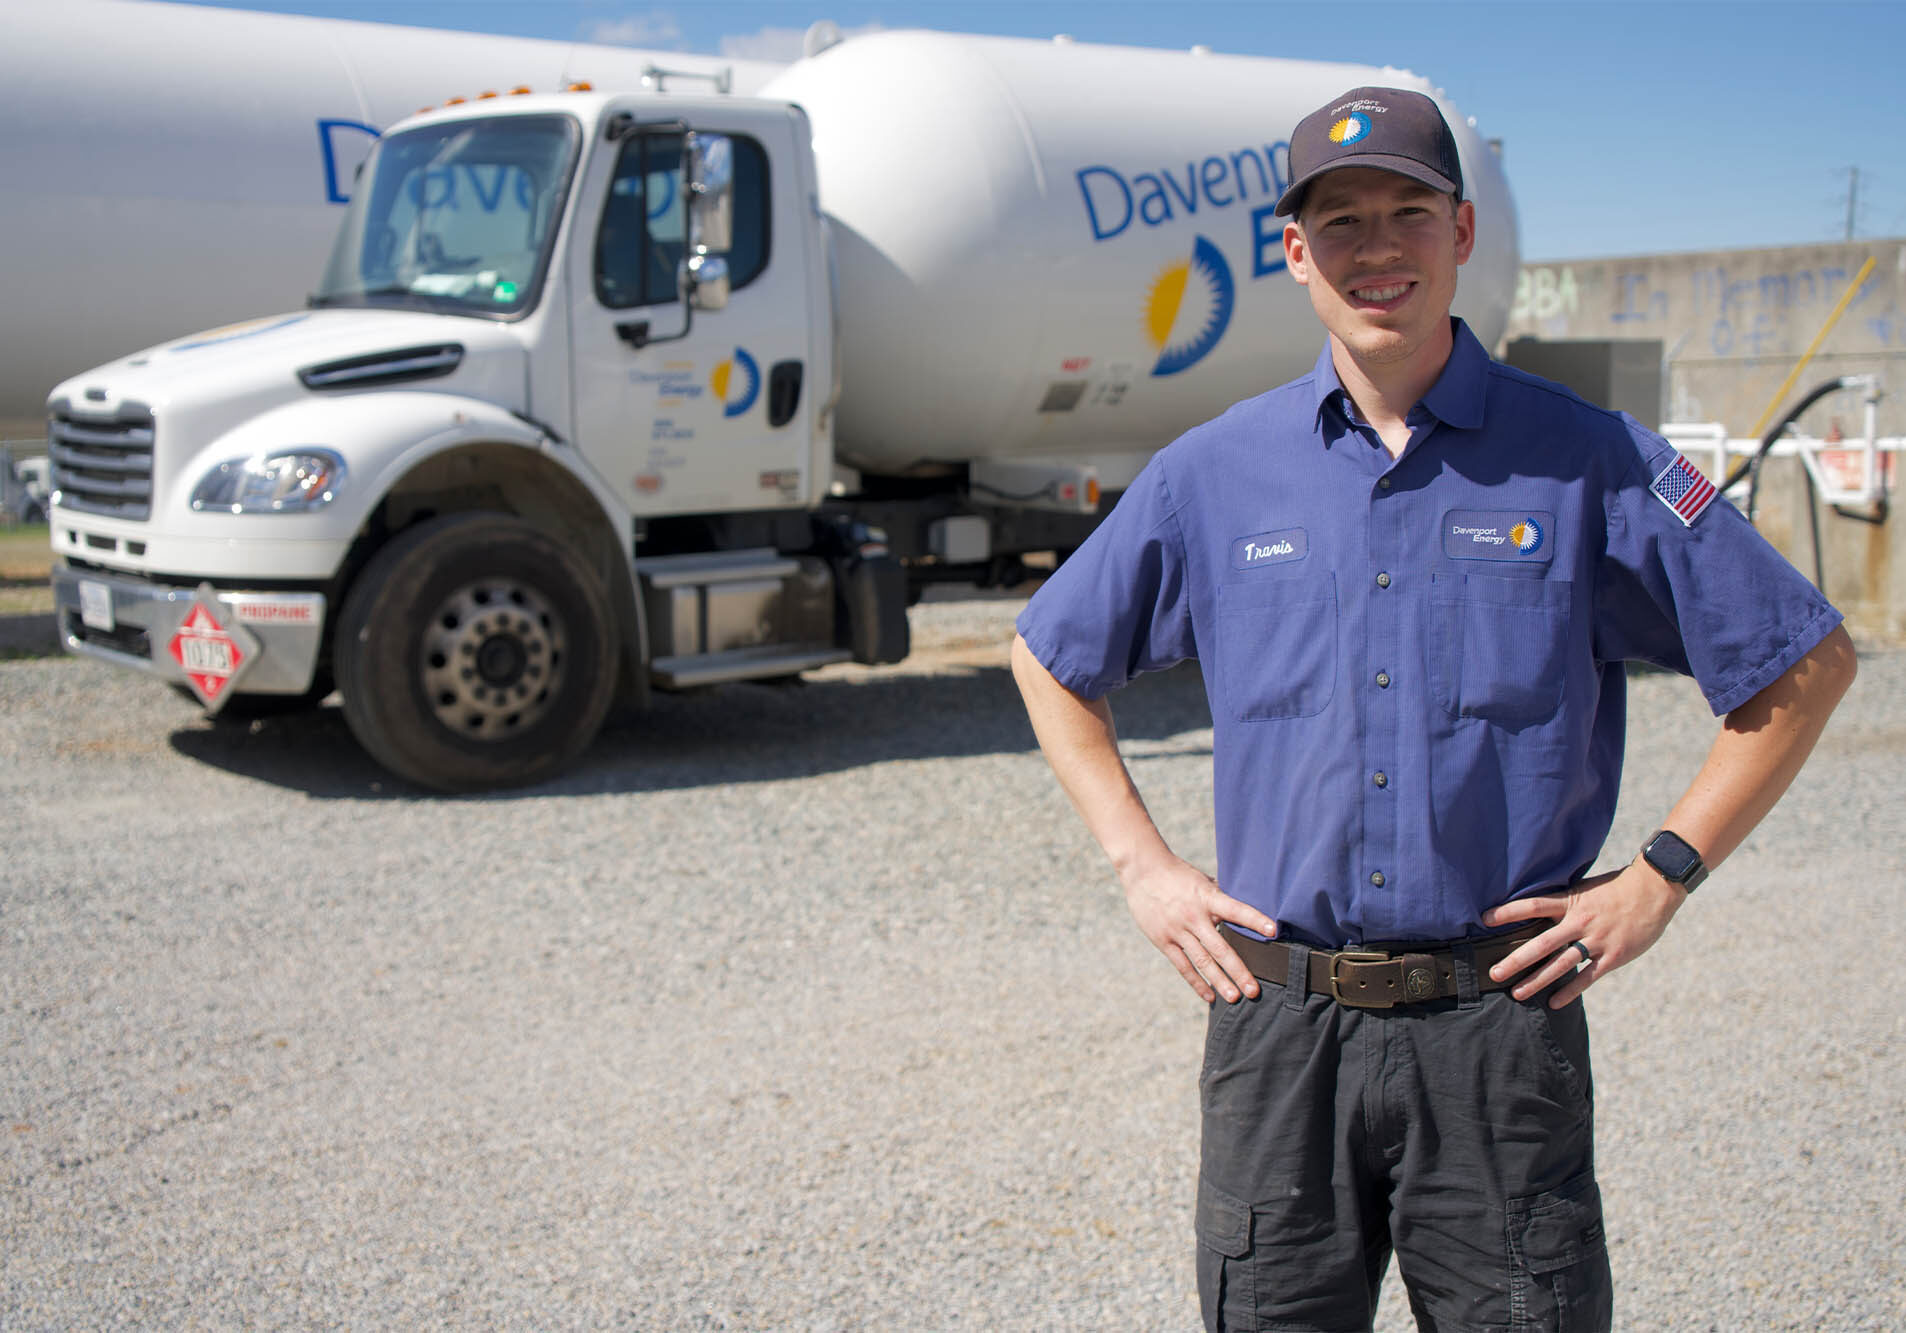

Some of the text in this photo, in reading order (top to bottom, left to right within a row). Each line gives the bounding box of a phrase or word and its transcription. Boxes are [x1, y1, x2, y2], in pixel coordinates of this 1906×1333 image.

[1330, 99, 1380, 116] Davenport
[1351, 104, 1389, 113] Energy
[1453, 526, 1497, 536] Davenport
[1473, 534, 1506, 545] Energy
[1245, 540, 1293, 560] Travis
